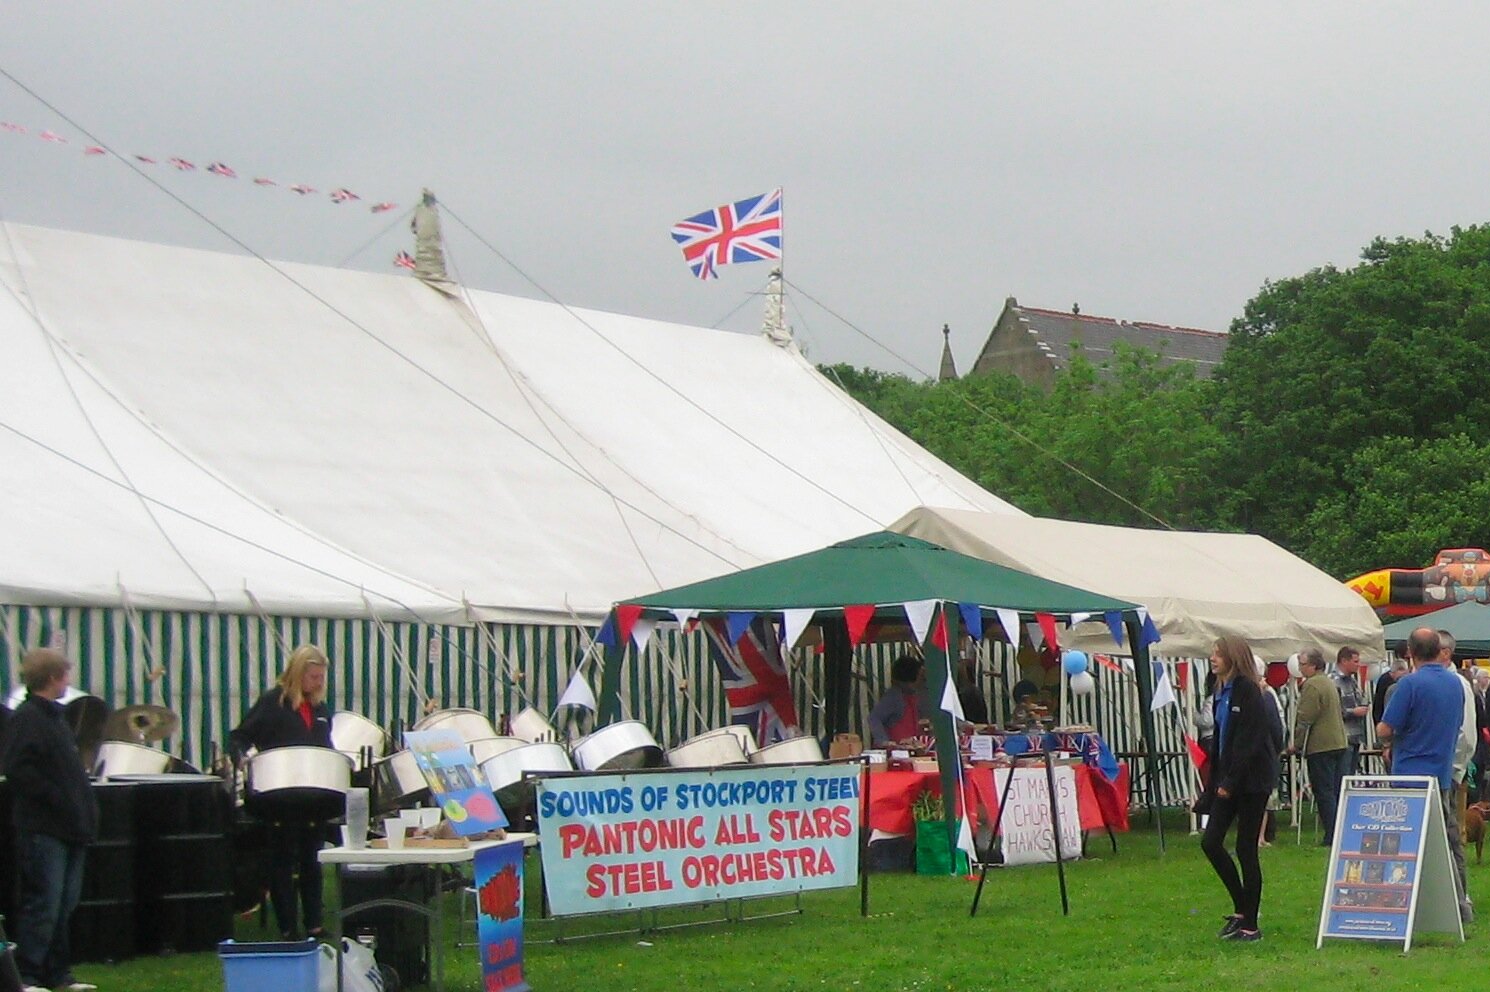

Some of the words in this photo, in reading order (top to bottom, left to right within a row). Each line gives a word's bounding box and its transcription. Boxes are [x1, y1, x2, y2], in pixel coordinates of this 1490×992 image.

[540, 786, 633, 819] SOUNDS
[641, 786, 668, 812] OF
[676, 780, 797, 810] STOCKPORT
[1008, 777, 1021, 800] ST
[1014, 803, 1067, 827] CHURH
[559, 815, 706, 859] PANTONIC
[714, 814, 760, 847] ALL
[768, 805, 853, 843] STARS
[1007, 826, 1077, 853] HAWKSAW
[586, 861, 673, 899] STEEL
[682, 846, 836, 890] ORCHESTRA
